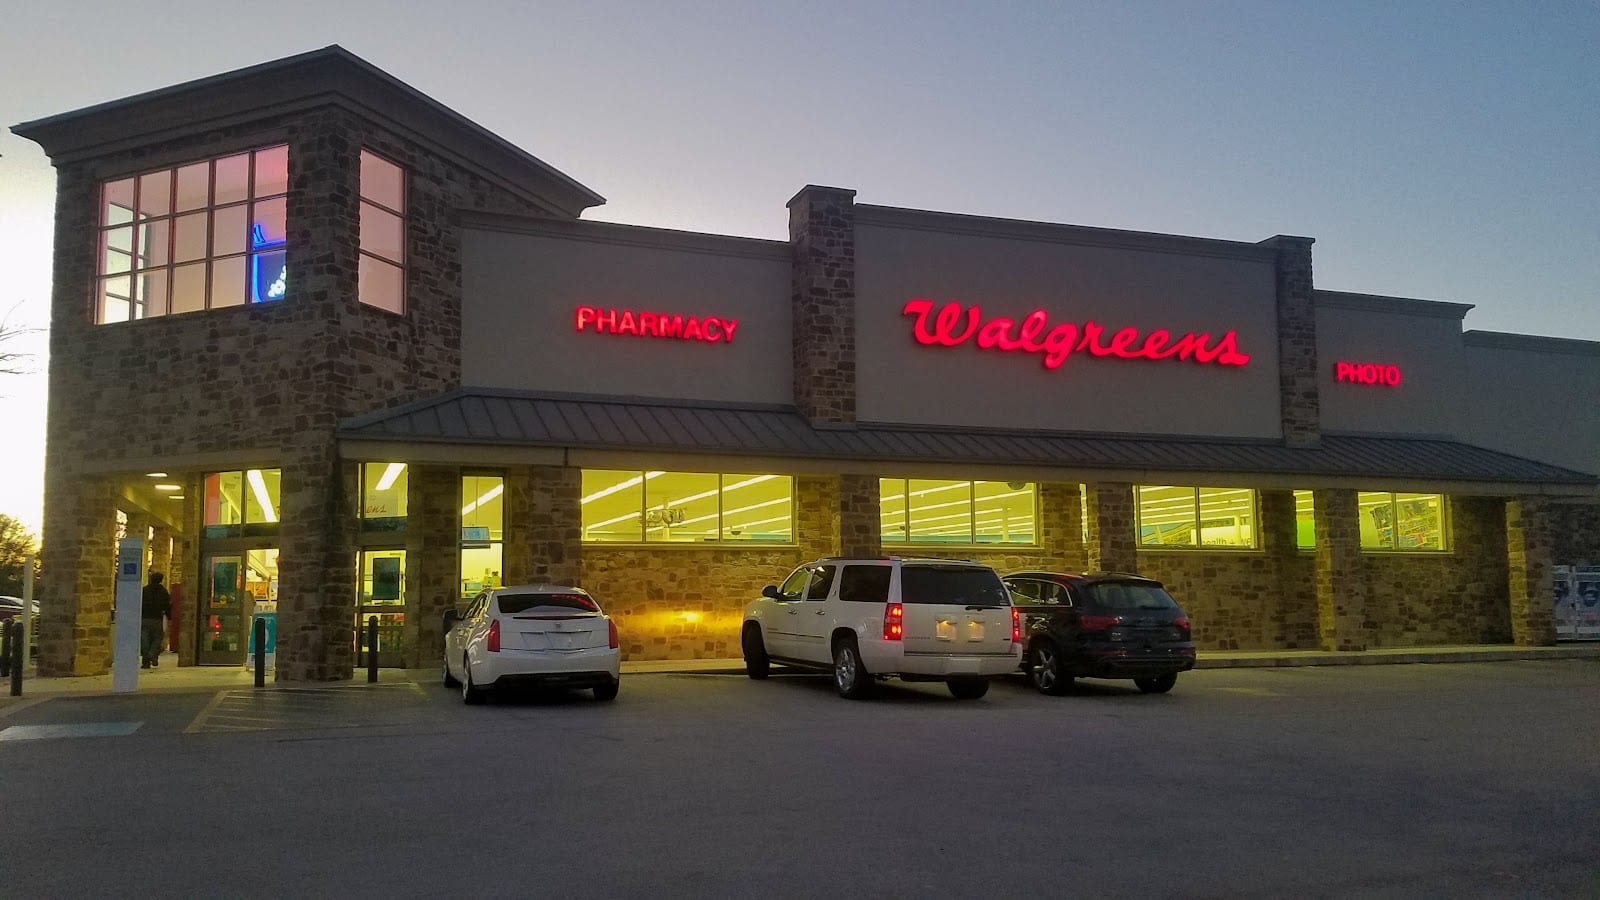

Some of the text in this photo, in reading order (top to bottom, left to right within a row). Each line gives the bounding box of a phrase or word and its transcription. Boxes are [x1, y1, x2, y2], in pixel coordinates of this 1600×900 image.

[575, 305, 738, 343] PHARMACY
[902, 298, 1250, 370] Walgreens
[1336, 361, 1402, 387] PHOTO
